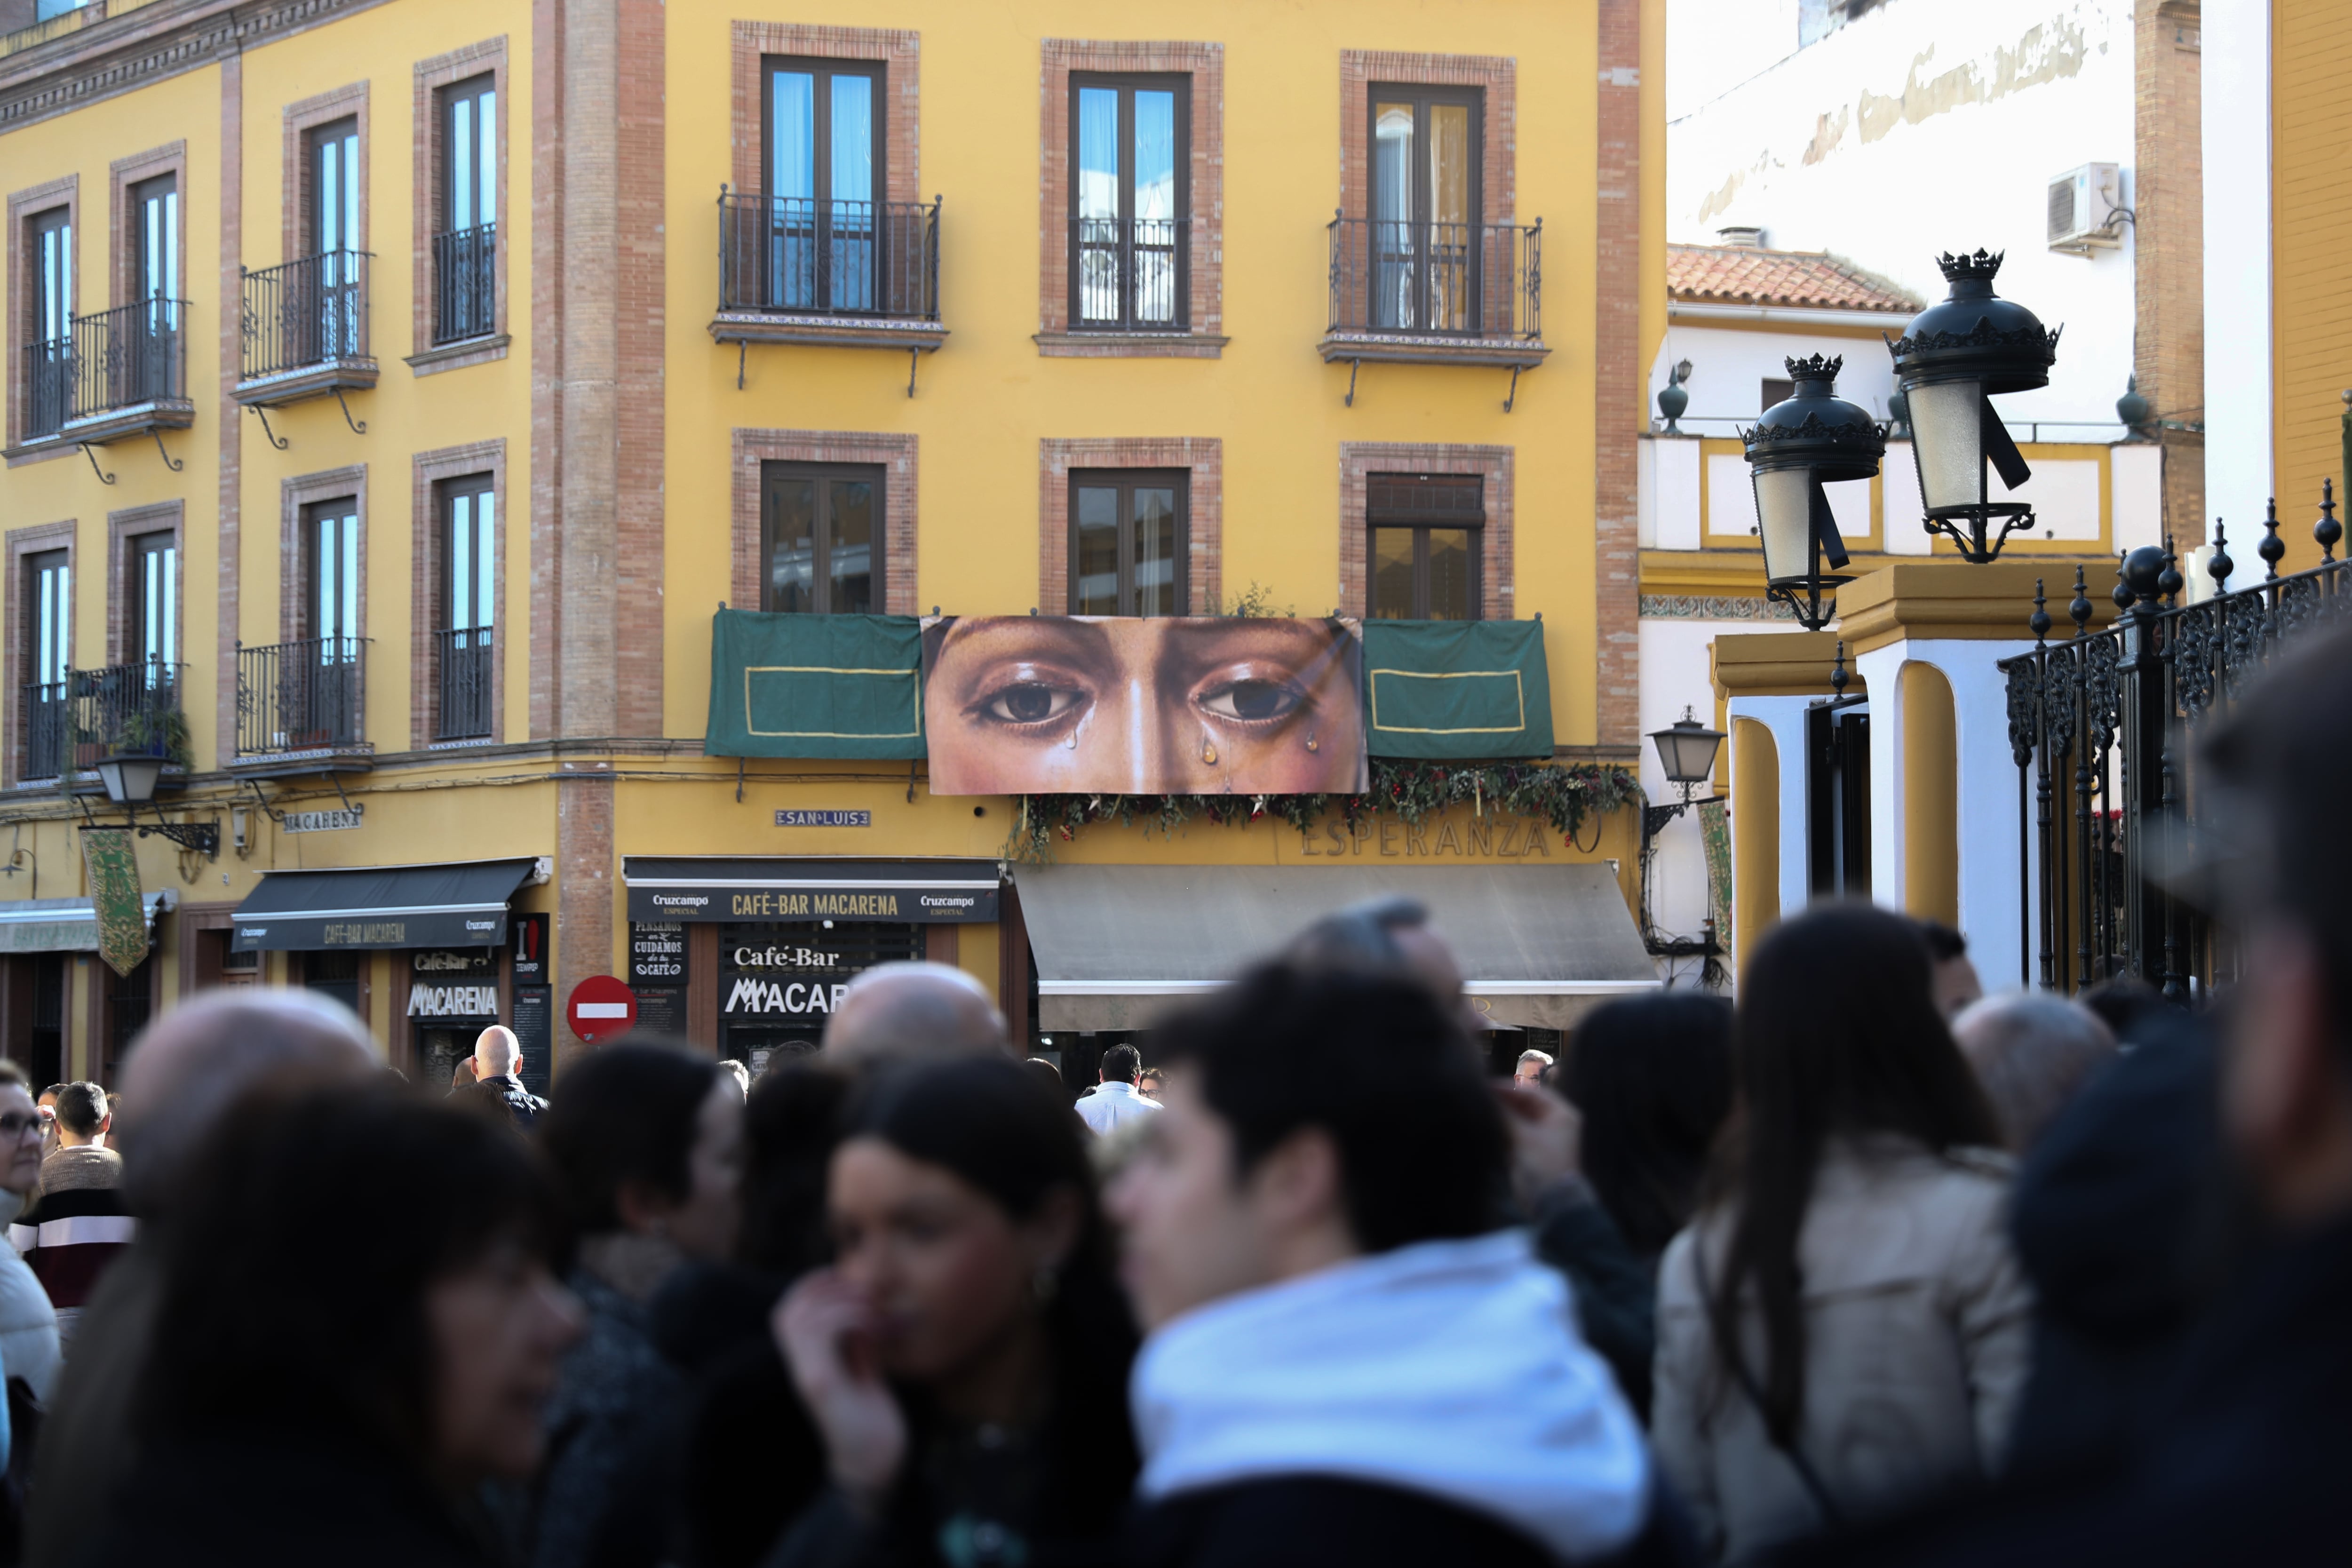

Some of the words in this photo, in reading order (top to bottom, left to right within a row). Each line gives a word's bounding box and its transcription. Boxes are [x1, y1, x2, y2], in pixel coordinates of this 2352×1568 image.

[786, 812, 817, 825] SAN
[823, 812, 859, 825] LUIS
[1302, 820, 1550, 856] ESPERANZA
[652, 894, 709, 907] Cruzcampo
[732, 891, 809, 915] CAFÉ-BAR
[814, 894, 898, 915] MACARENA
[920, 895, 974, 907] Cruzcampo
[364, 922, 405, 943] MACARENA
[634, 941, 682, 953] CUIDAMOS
[734, 945, 840, 966] Café-Bar
[647, 962, 670, 976] CAFÉ
[407, 983, 498, 1017] MACARENA
[725, 977, 850, 1013] MACAR
